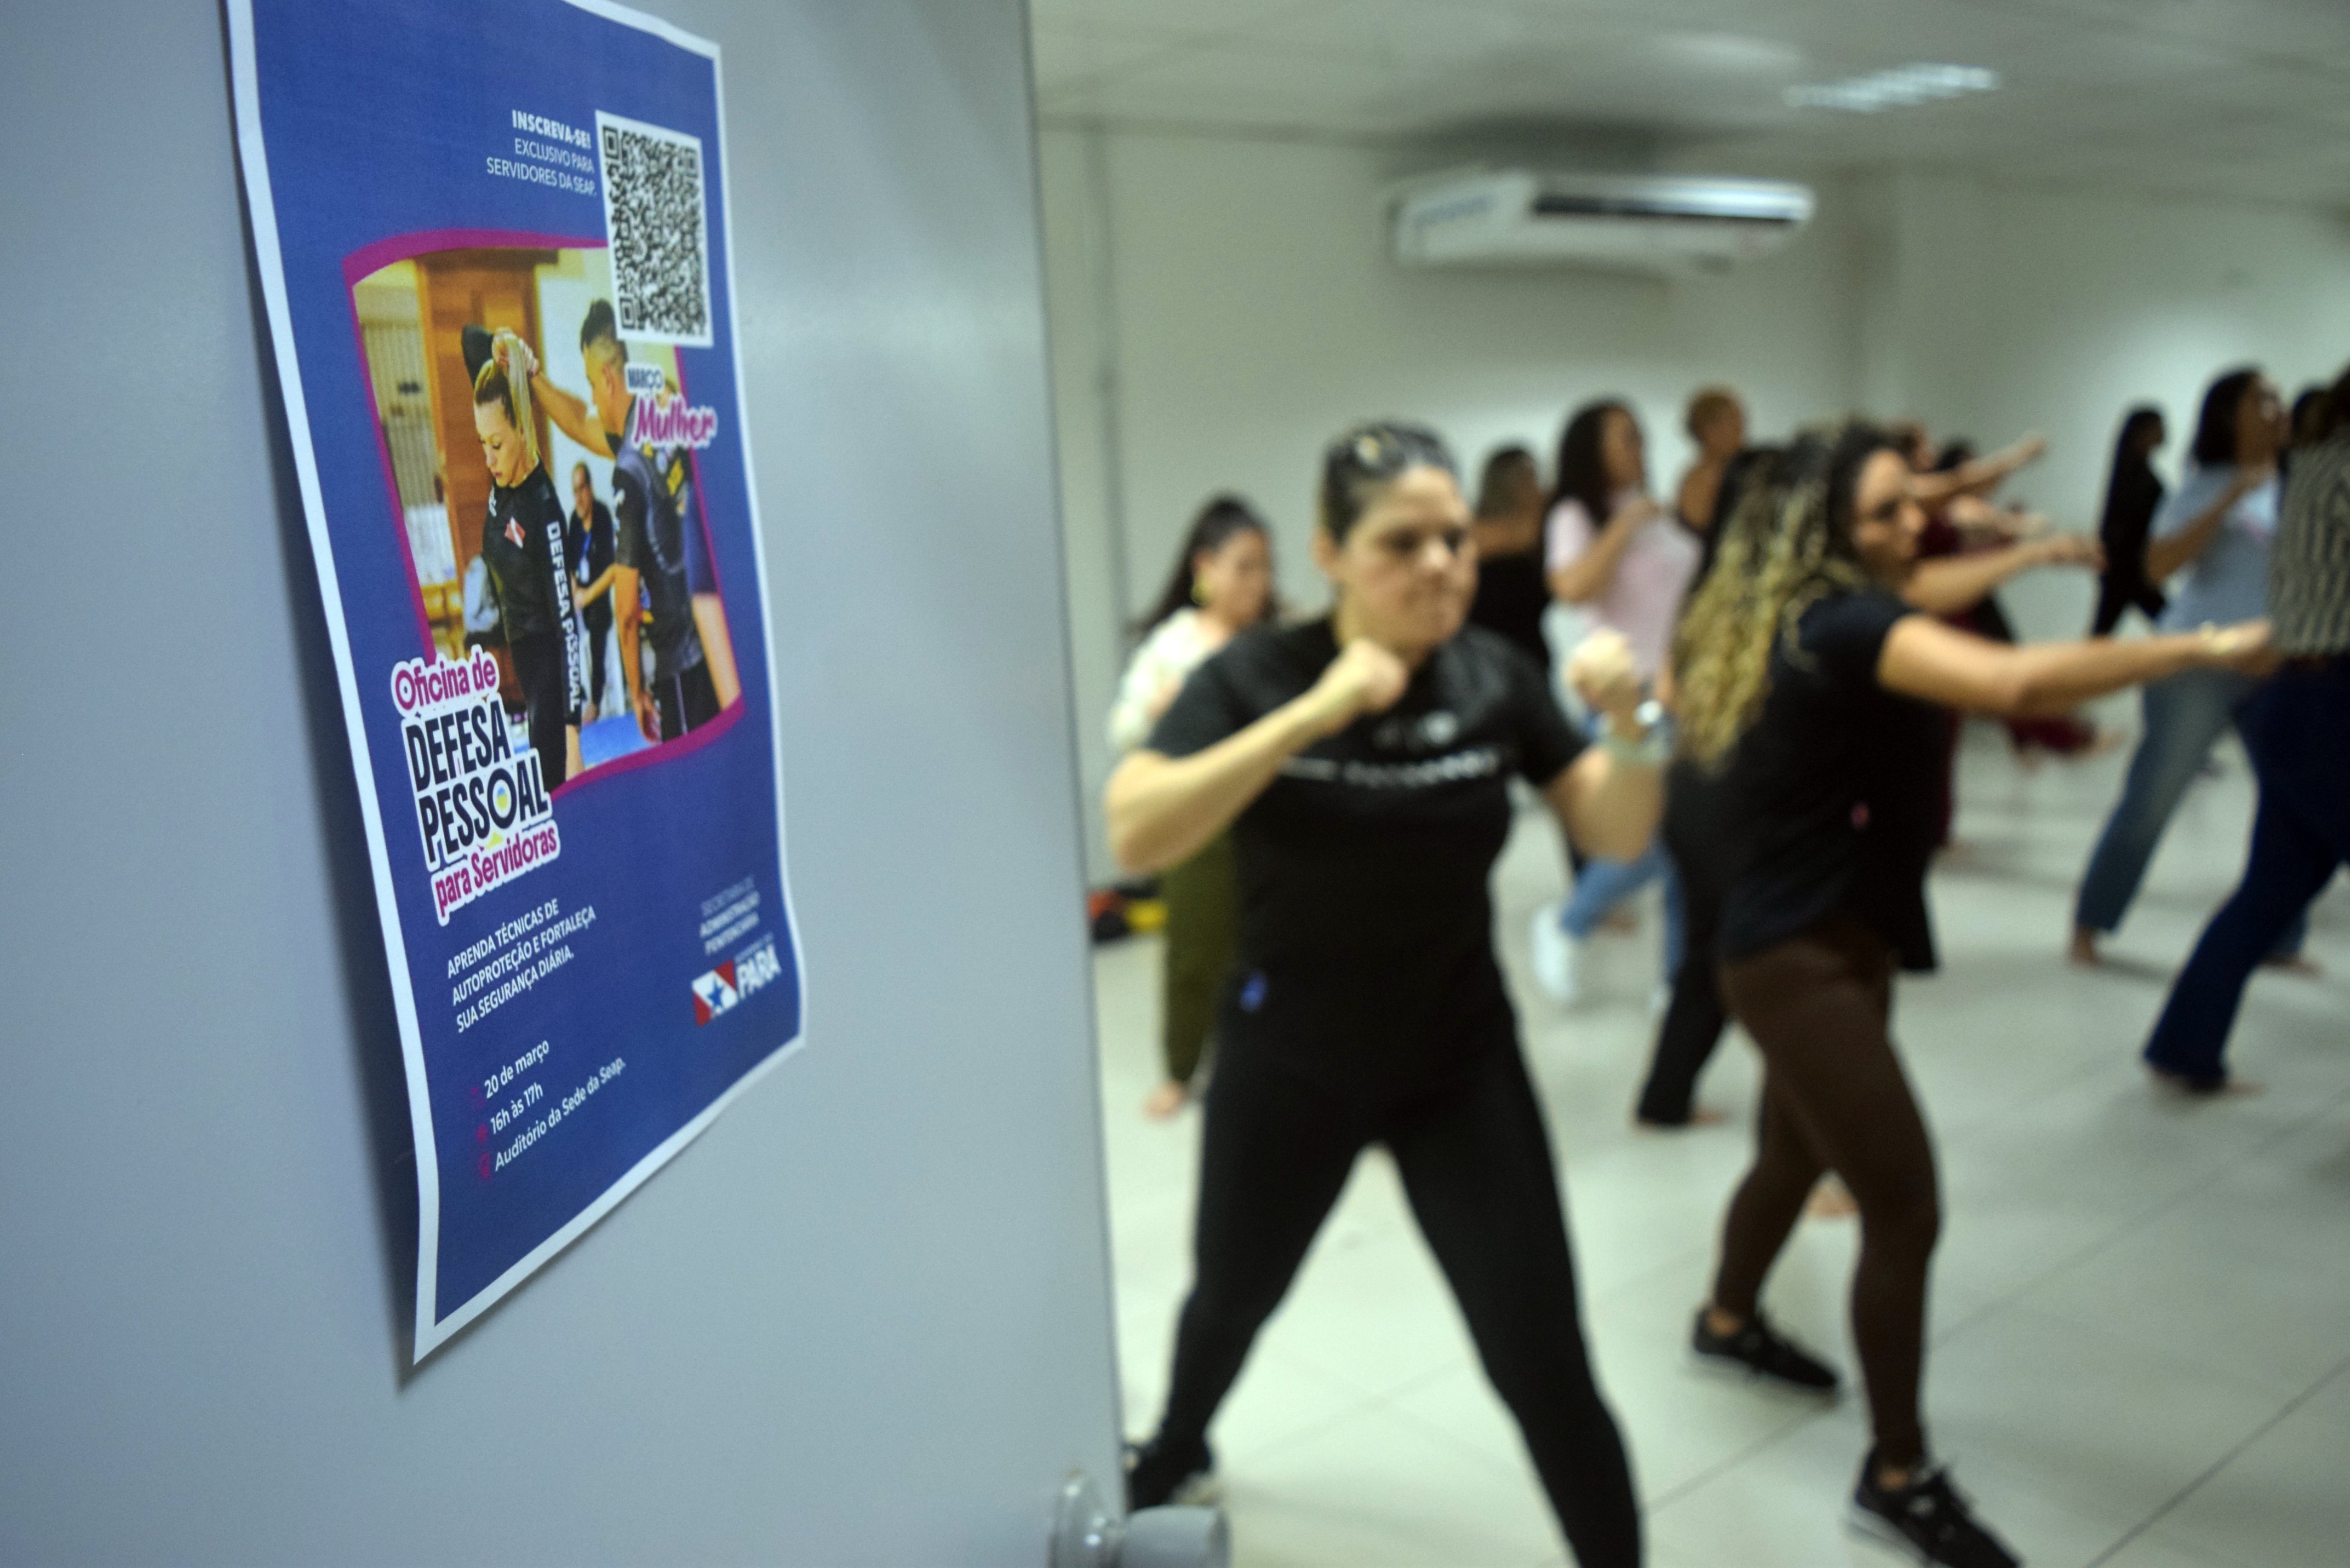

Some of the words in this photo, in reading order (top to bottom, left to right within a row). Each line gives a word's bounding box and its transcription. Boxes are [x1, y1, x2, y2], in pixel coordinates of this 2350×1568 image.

[512, 110, 592, 150] INSCREVA-SE!
[515, 137, 570, 167] EXCLUSIVO
[571, 152, 595, 175] PARA
[486, 156, 557, 187] SERVIDORES
[559, 171, 573, 190] DA
[573, 176, 597, 197] SEAP.
[634, 396, 714, 443] Mulher
[547, 521, 571, 618] DEFESA
[395, 660, 470, 710] Oficina
[472, 652, 496, 691] de
[405, 700, 511, 792] DEFESA
[419, 755, 548, 864] PESSOAL
[435, 867, 472, 918] para
[471, 826, 558, 889] Servidoras
[448, 934, 496, 979] APRENDA
[495, 906, 544, 947] TÉCNICAS
[544, 898, 559, 920] DE
[453, 941, 532, 1007] AUTOPROTEÇÃO
[533, 936, 540, 954] E
[540, 905, 597, 949] FORTALEÇA
[456, 1005, 479, 1033] SUA
[478, 965, 539, 1018] SEGURANÇA
[538, 945, 574, 978] DIÁRIA.
[484, 1075, 498, 1099] 20
[500, 1065, 514, 1086] de
[515, 1040, 549, 1075] março
[490, 1108, 511, 1135] 16h
[511, 1098, 524, 1119] às
[524, 1082, 543, 1108] 17h
[495, 1120, 547, 1173] Auditório
[548, 1107, 562, 1128] da
[562, 1087, 586, 1116] Sede
[587, 1076, 600, 1095] da
